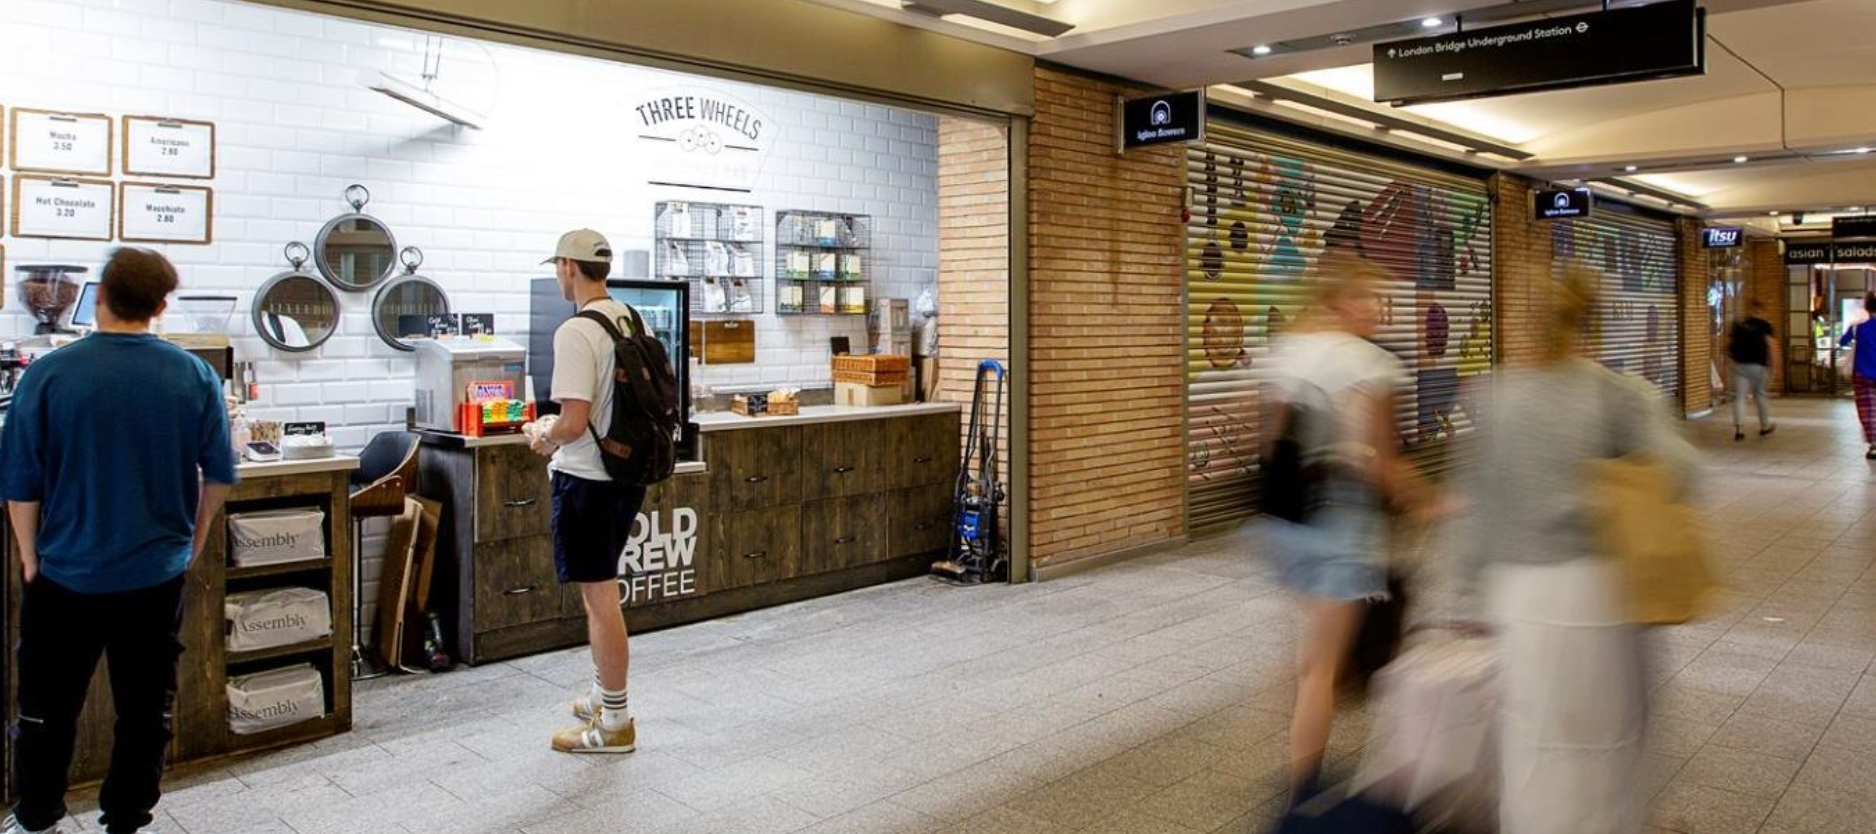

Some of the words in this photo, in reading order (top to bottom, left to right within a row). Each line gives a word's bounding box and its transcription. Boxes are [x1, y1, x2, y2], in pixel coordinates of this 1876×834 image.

[1398, 46, 1434, 57] London
[1435, 40, 1466, 53] Bridge
[1467, 29, 1532, 48] Underground
[1534, 26, 1572, 39] Station
[635, 97, 695, 127] THREE
[699, 98, 762, 140] WHEELS
[35, 197, 52, 206] Hot
[54, 197, 96, 208] Chocolate
[1709, 228, 1737, 243] itsu
[1788, 248, 1824, 259] asian
[626, 507, 698, 546] OLD
[617, 536, 697, 575] REW
[617, 569, 696, 605] OFFEE
